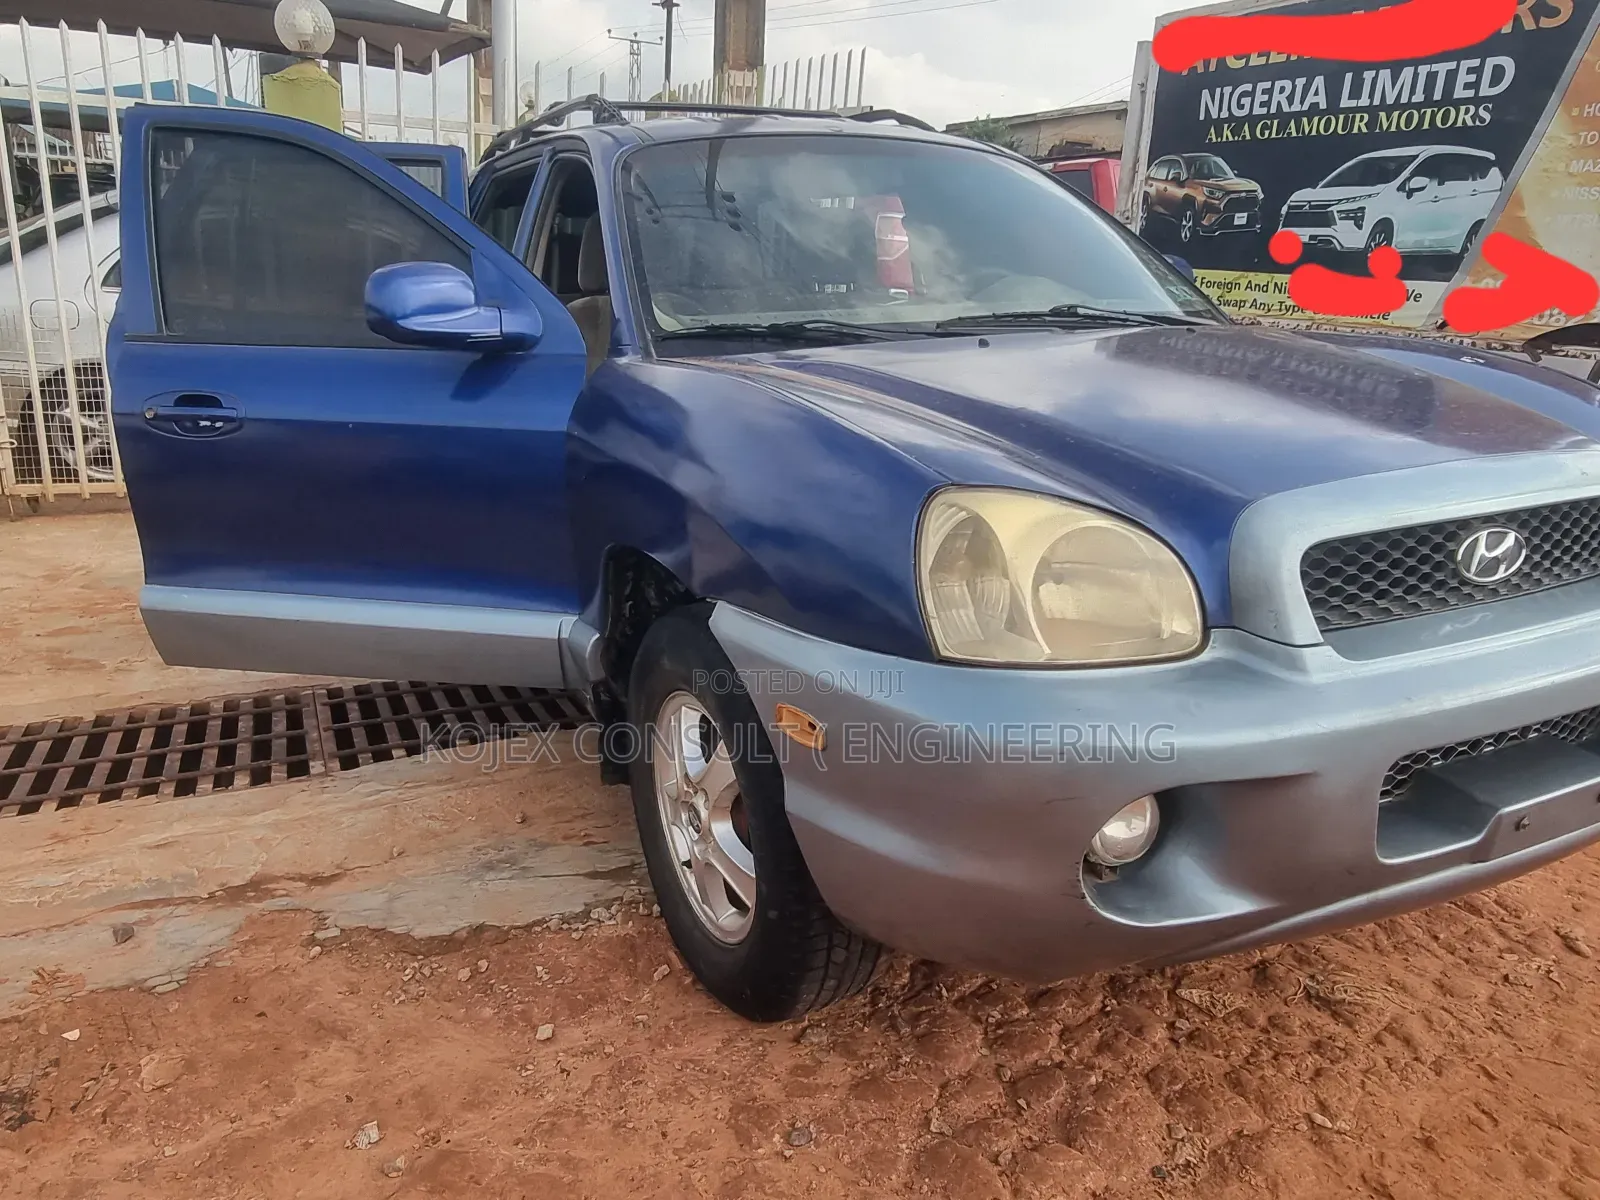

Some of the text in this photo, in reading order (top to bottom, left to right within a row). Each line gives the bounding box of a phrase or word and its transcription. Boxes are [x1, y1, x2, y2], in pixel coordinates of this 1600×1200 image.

[1199, 75, 1327, 121] NIGERIA
[1340, 55, 1515, 109] LIMITED
[1206, 103, 1493, 143] A.K.A GLAMOUR MOTORS
[1200, 276, 1242, 293] Foreign
[1244, 280, 1270, 294] And
[1216, 295, 1247, 311] Swap
[1248, 298, 1275, 315] Any
